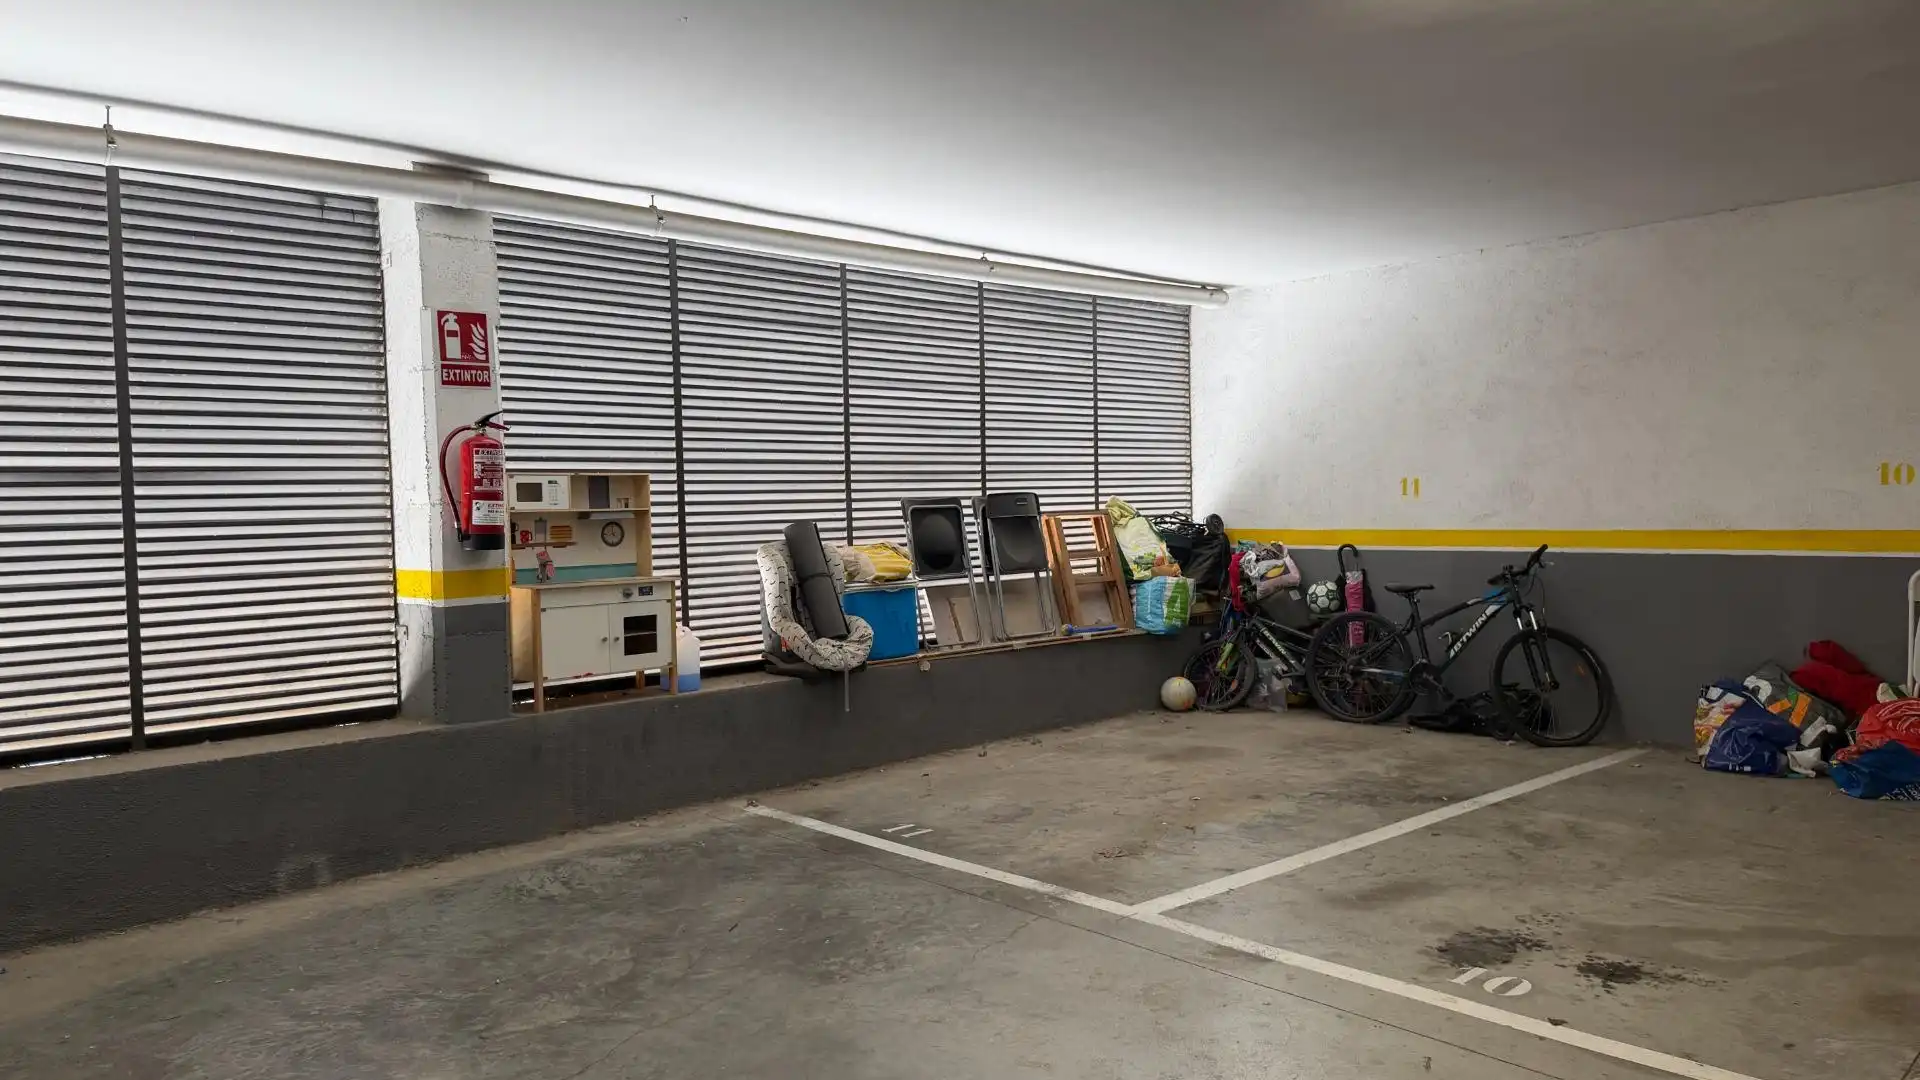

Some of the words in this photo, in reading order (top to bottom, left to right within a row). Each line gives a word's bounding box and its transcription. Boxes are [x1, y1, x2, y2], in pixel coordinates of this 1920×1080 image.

[442, 369, 489, 382] EXTINTOR
[1877, 462, 1915, 486] 10
[1400, 477, 1419, 499] 11
[881, 823, 934, 838] 11
[1447, 966, 1532, 996] 10
